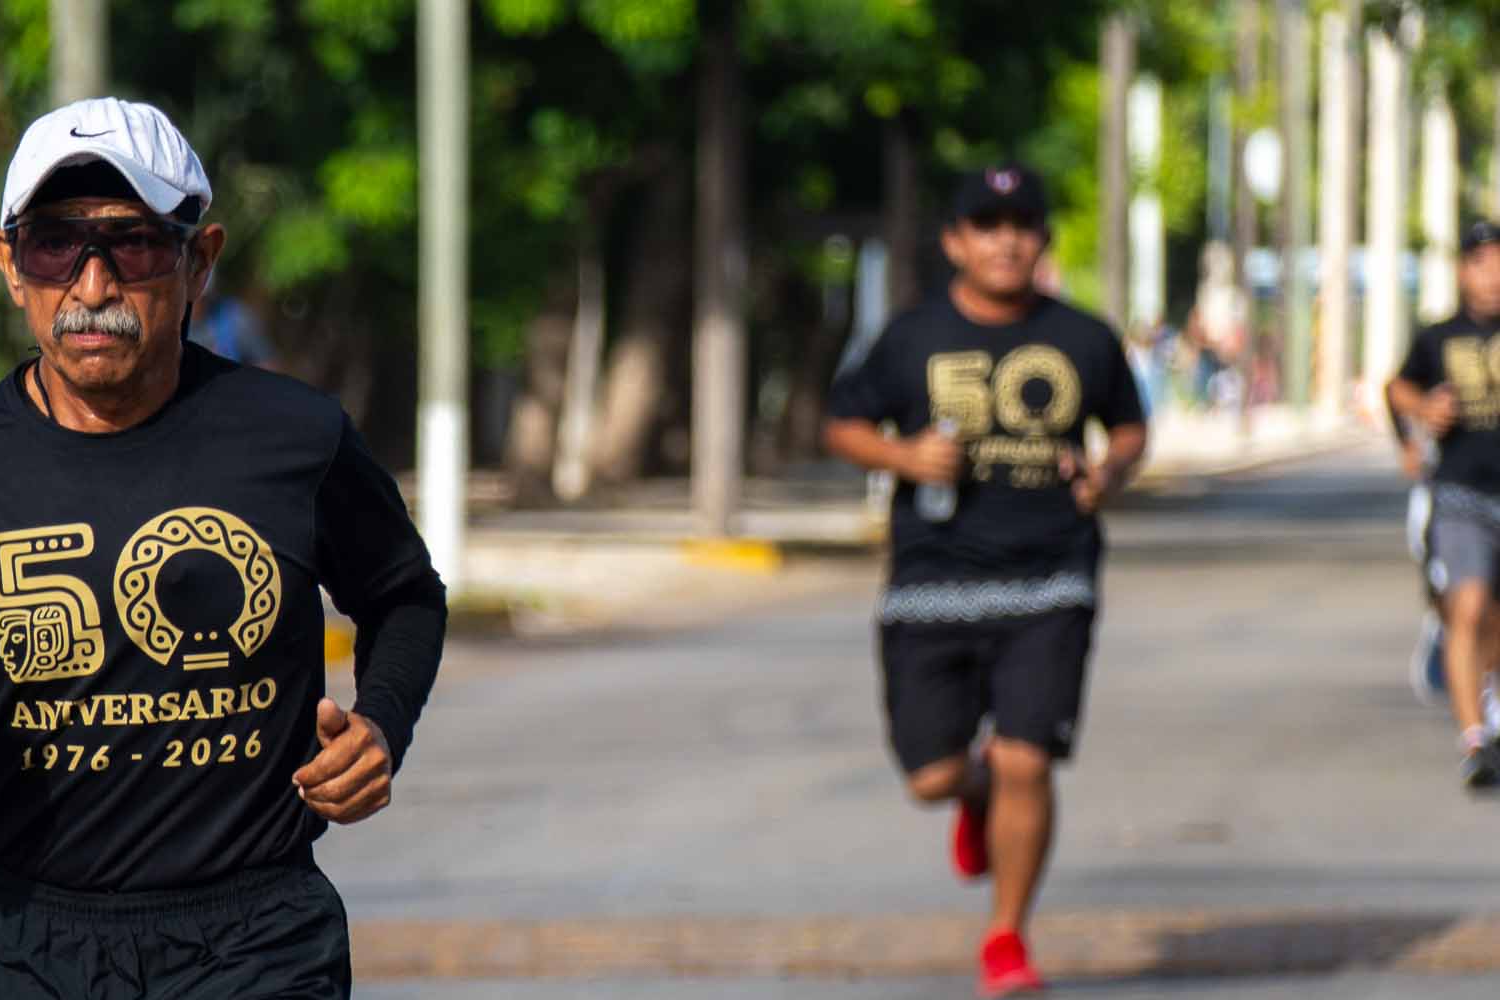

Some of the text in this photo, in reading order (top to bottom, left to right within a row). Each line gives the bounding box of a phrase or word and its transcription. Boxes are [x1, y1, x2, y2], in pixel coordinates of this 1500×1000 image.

[11, 677, 277, 731] ANIVERSARIO
[21, 744, 111, 772] 1976
[162, 730, 262, 767] 2026
